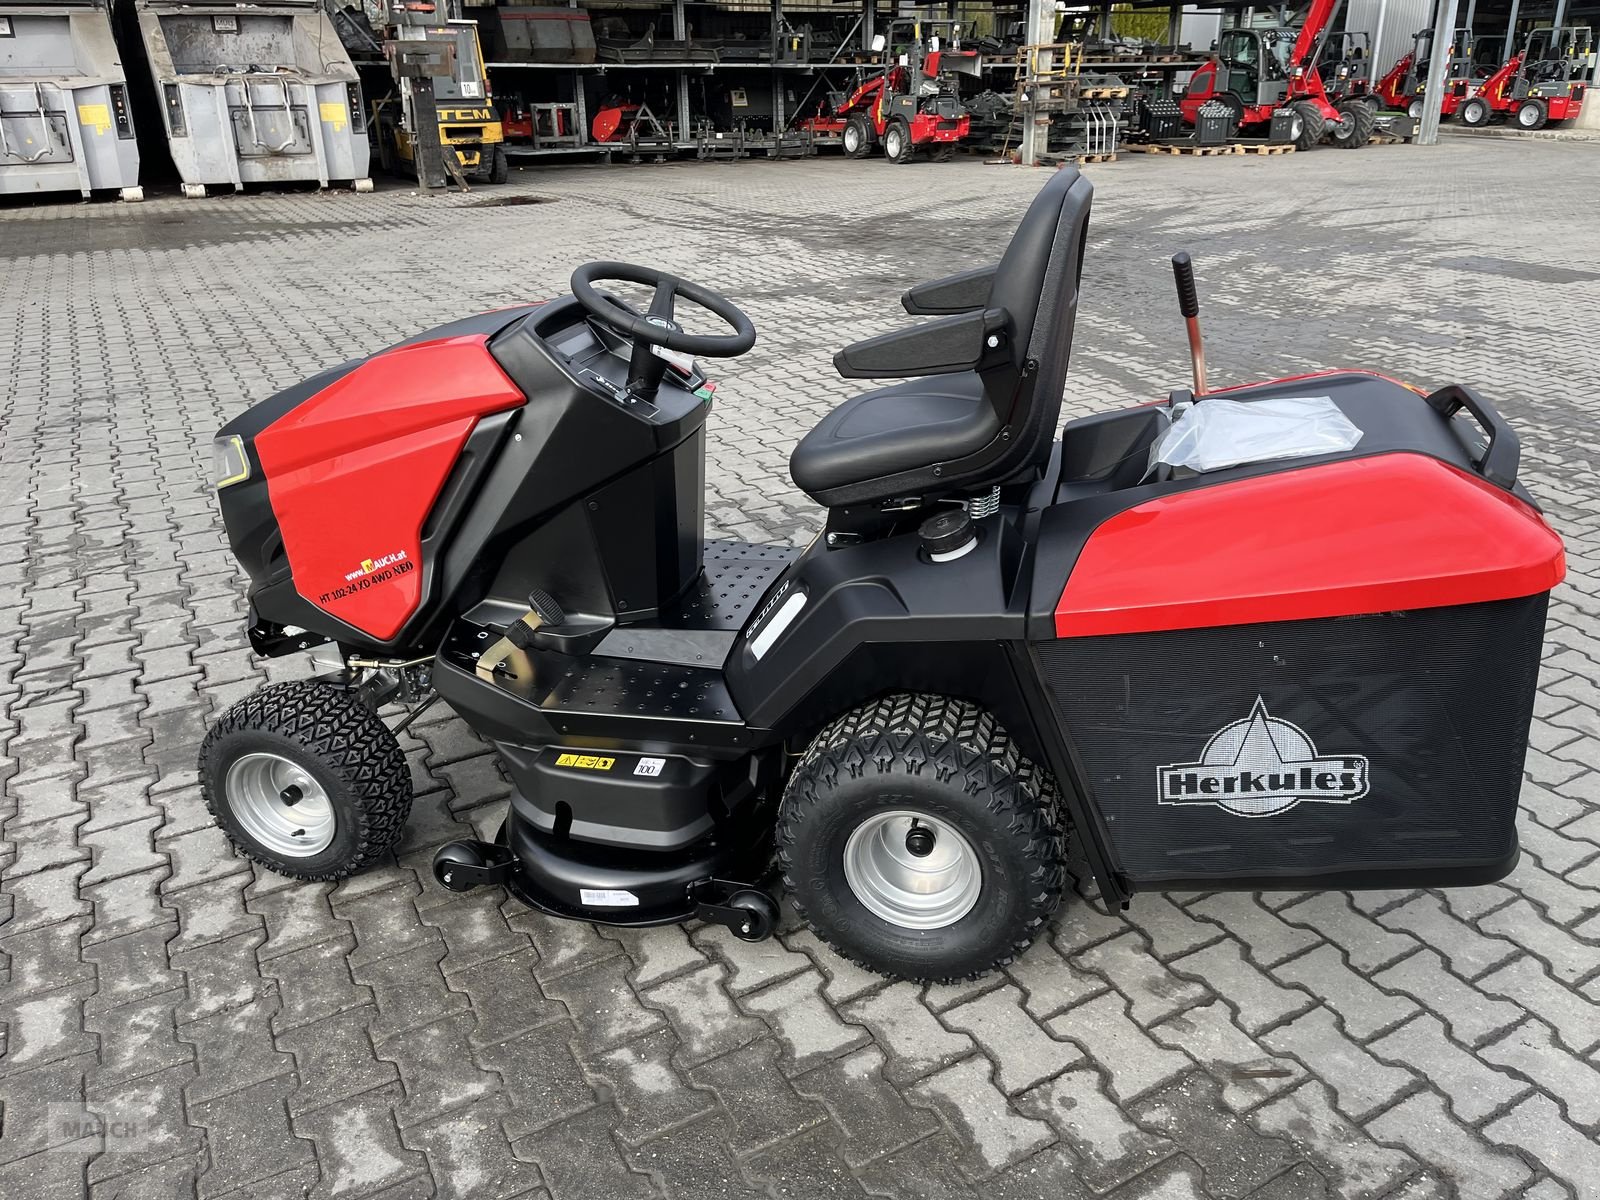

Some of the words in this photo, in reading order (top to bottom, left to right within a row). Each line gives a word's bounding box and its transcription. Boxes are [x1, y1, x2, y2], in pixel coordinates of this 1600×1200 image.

[437, 109, 491, 120] TCM
[344, 550, 407, 582] www.MAUCH.at
[319, 592, 331, 604] HT
[331, 583, 358, 600] 102-24
[358, 578, 371, 591] XD
[371, 570, 393, 585] 4WD
[392, 560, 414, 577] NEO
[638, 764, 655, 775] 100
[1168, 767, 1357, 796] Herkules
